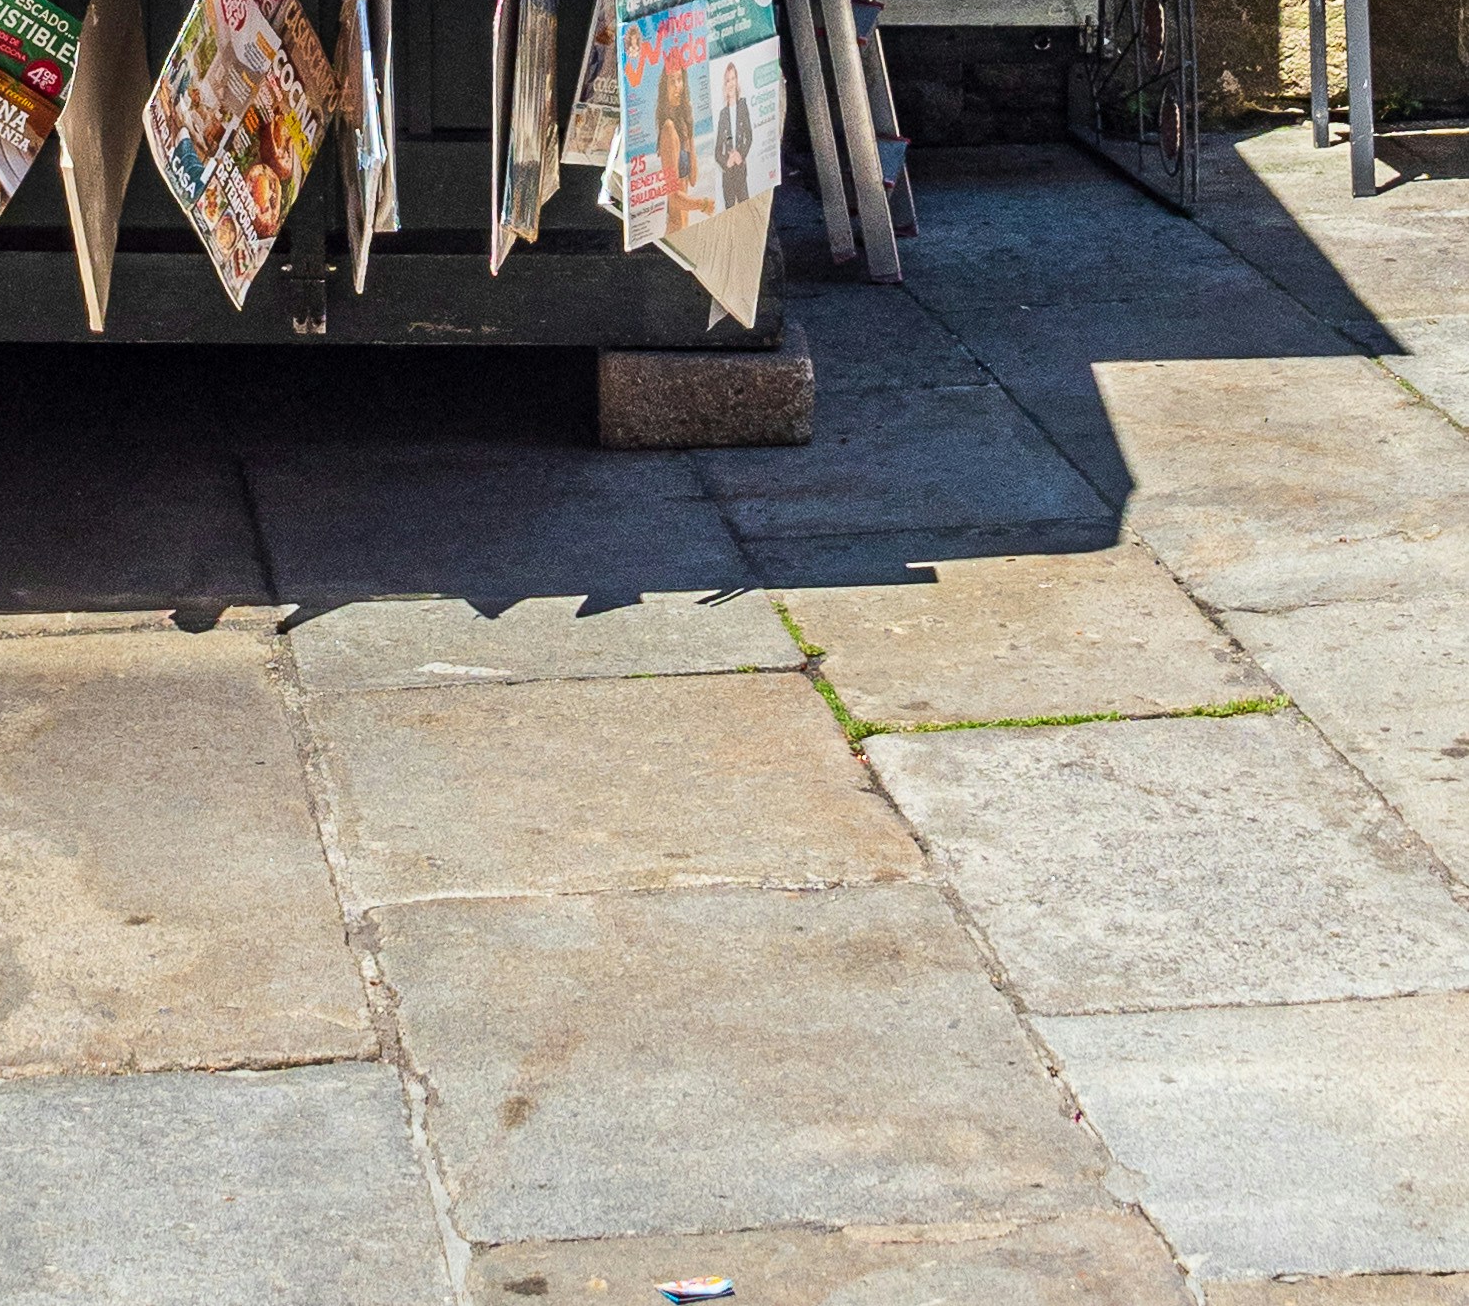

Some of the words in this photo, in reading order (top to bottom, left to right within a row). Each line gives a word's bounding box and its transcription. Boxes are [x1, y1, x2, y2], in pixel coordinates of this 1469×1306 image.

[663, 33, 708, 74] vida
[273, 49, 318, 141] COCINA
[172, 156, 197, 199] CASA
[630, 155, 646, 177] 25
[224, 181, 260, 252] TEMPORADA
[230, 166, 262, 221] RECETAS
